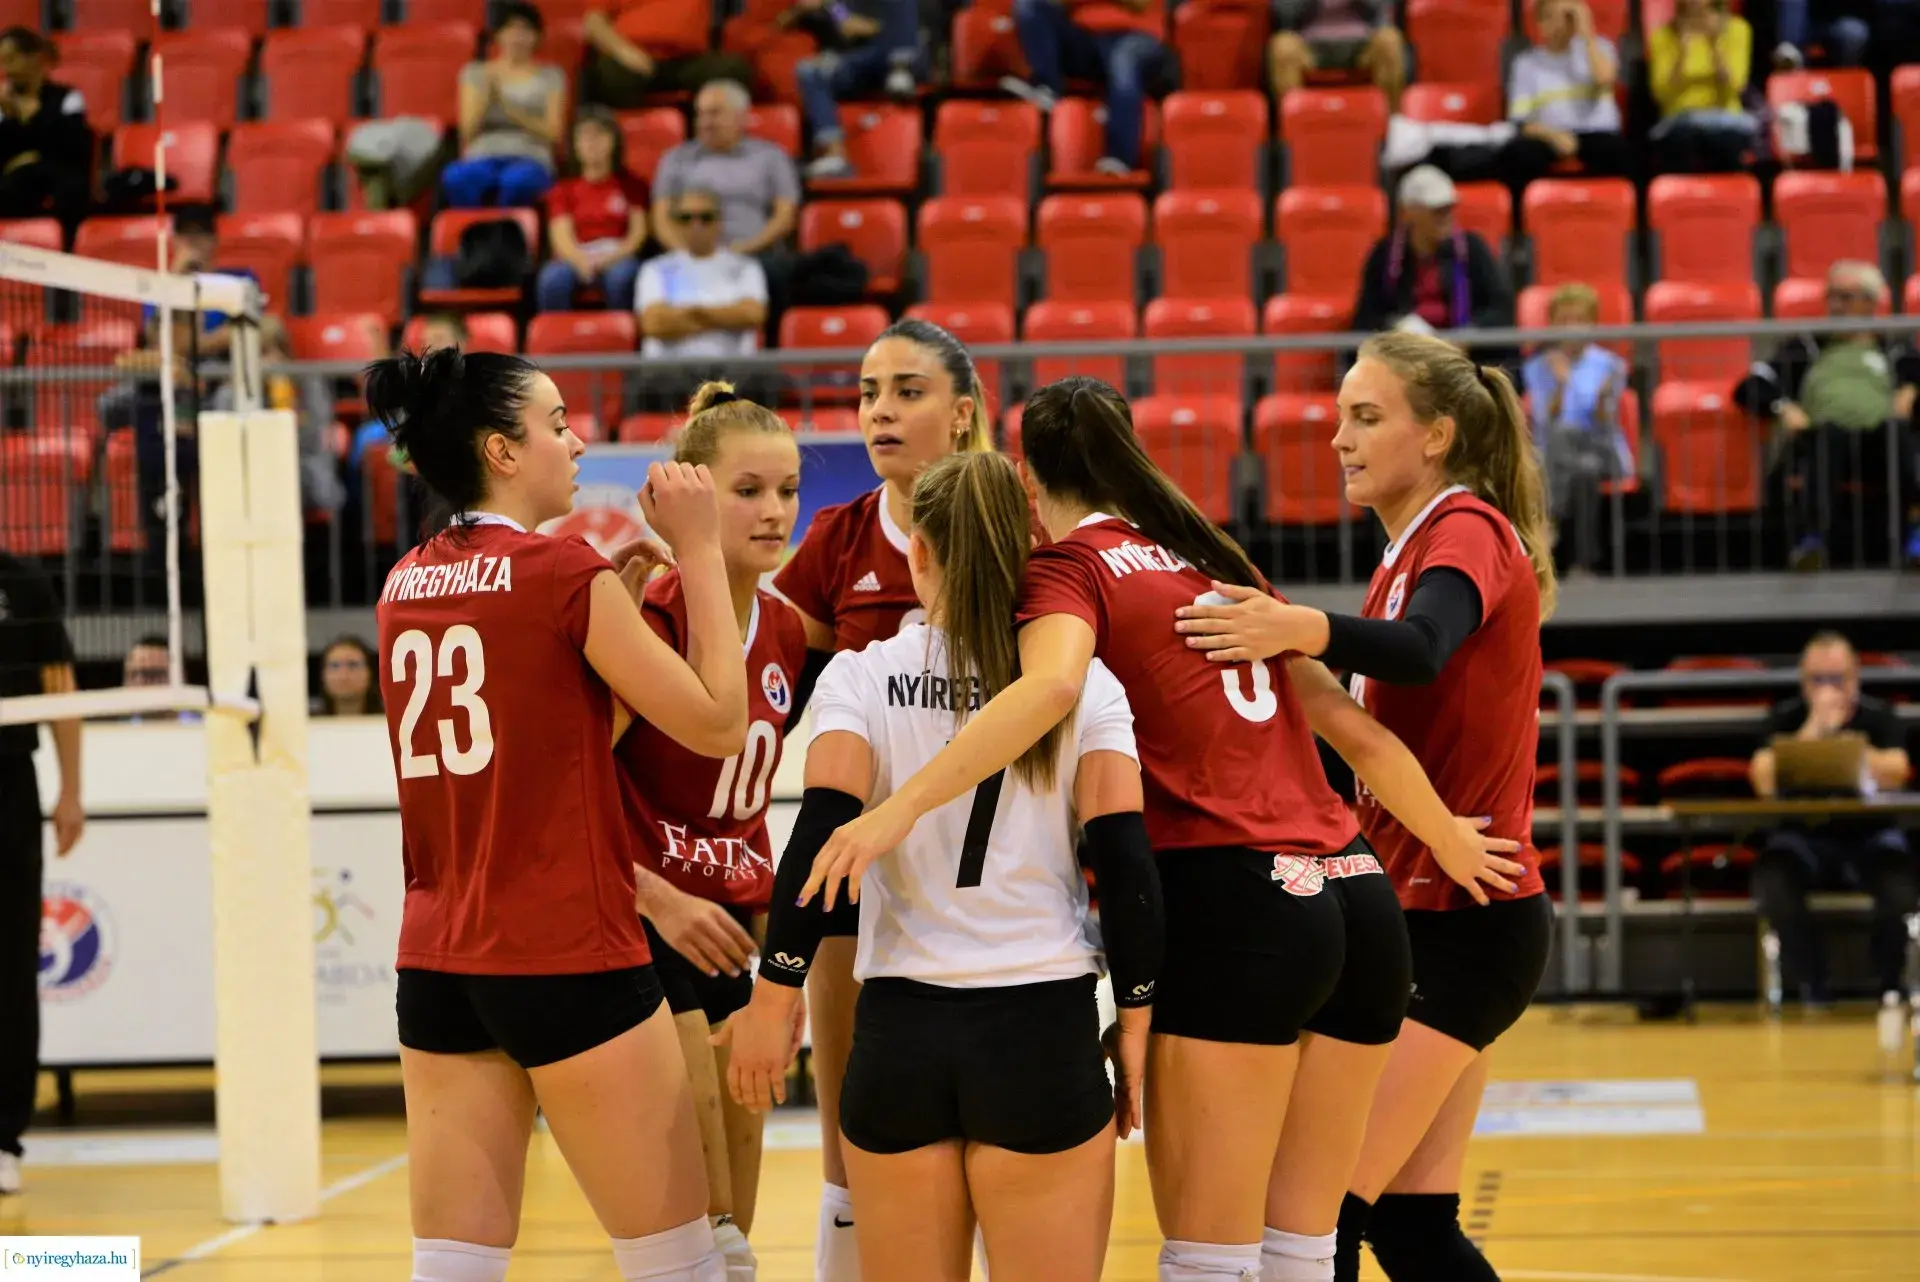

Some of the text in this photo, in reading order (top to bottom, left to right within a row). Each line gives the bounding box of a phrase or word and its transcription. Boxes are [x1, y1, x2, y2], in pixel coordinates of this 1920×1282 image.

[382, 553, 512, 605] NYÍREGYHÁZA
[391, 624, 495, 780] 23
[887, 669, 982, 712] NYÍREG
[707, 719, 777, 821] 10
